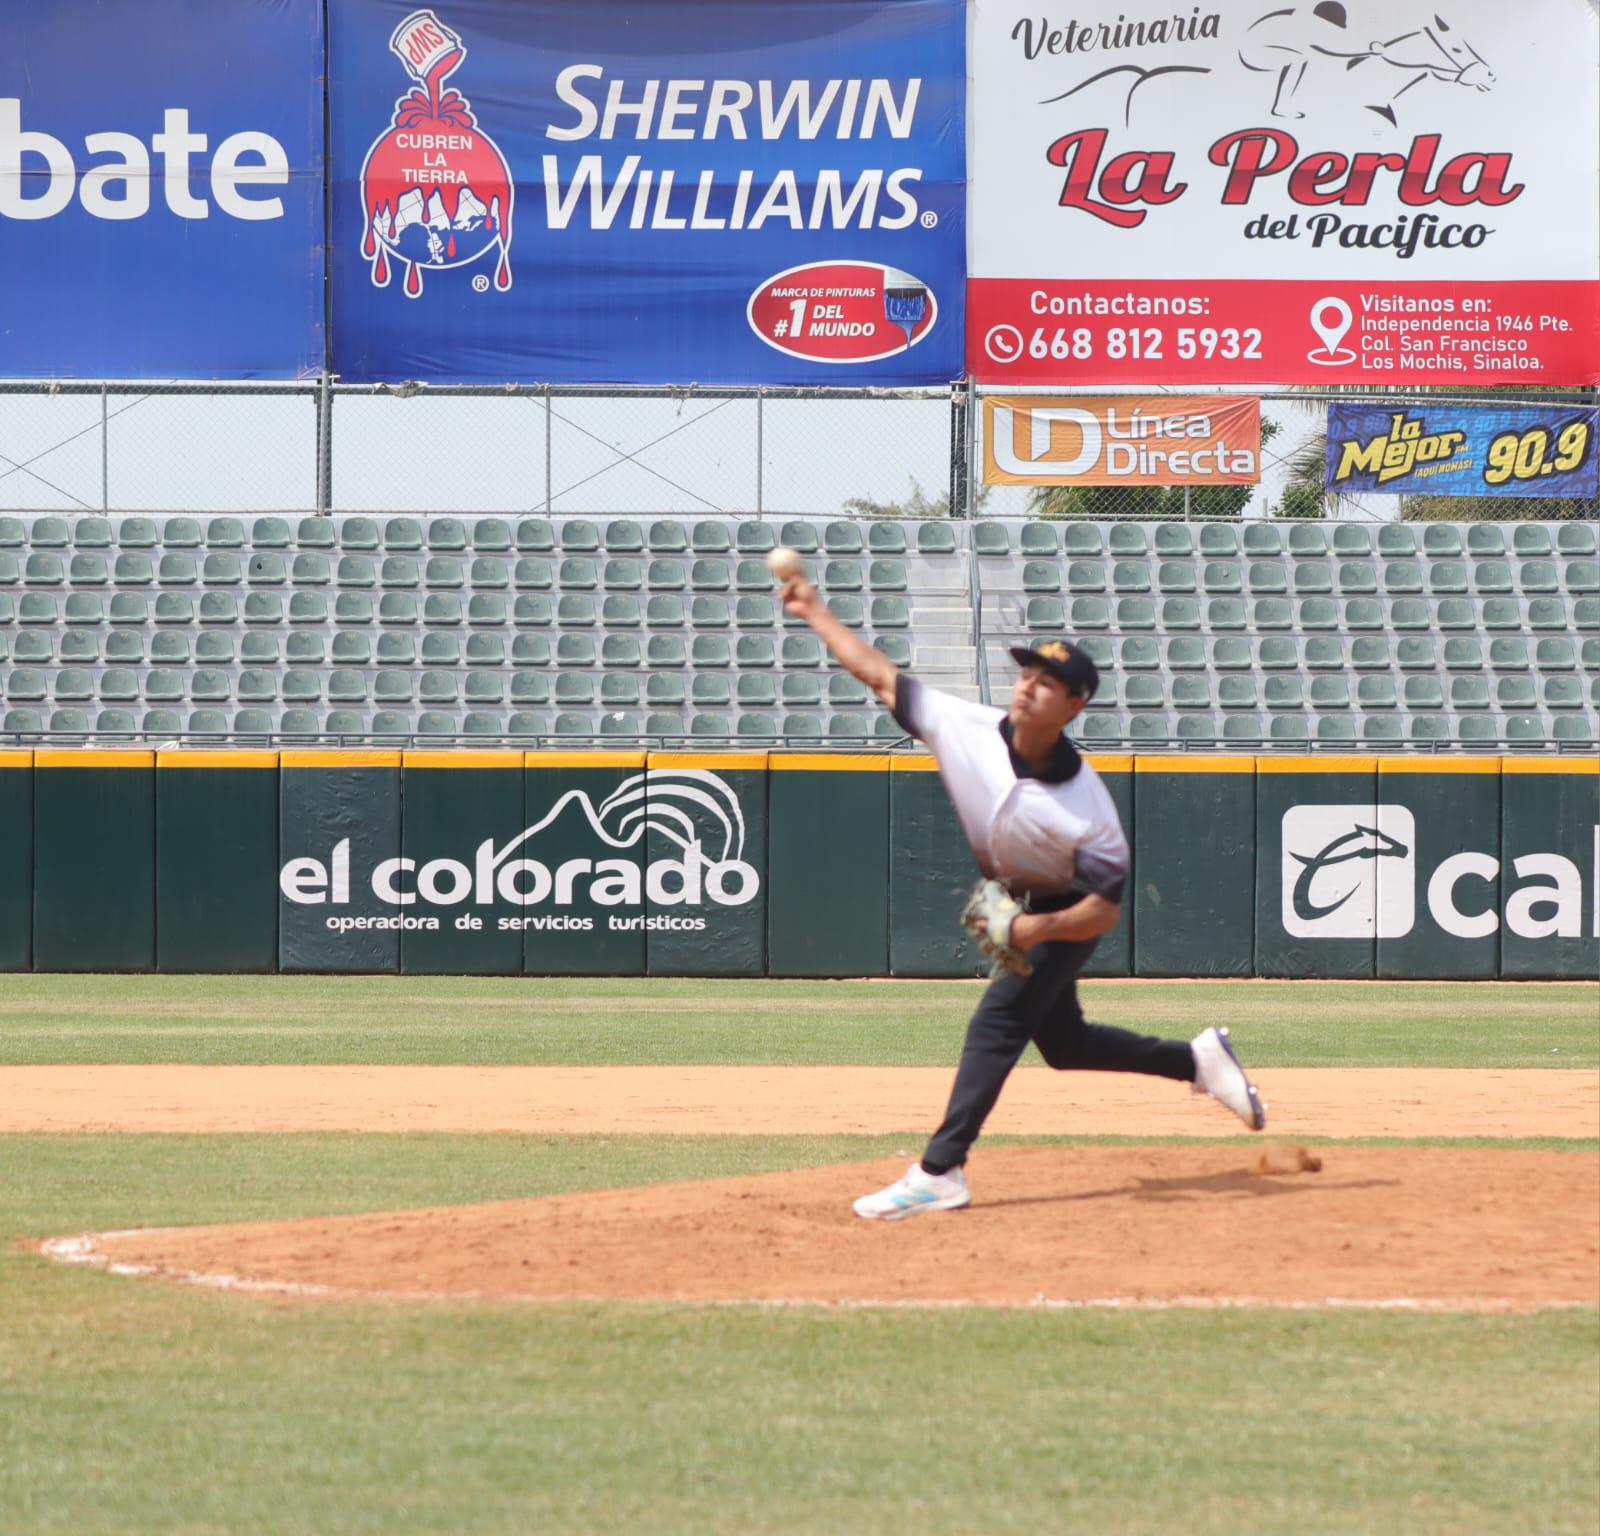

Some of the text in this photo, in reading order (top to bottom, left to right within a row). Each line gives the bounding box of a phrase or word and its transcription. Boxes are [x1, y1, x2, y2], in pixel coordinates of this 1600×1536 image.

[405, 22, 444, 65] SWP
[1012, 7, 1221, 60] Veterinaria
[545, 64, 922, 142] SHERWIN
[396, 133, 473, 150] CUBREN
[0, 97, 289, 220] bate
[423, 152, 447, 167] LA
[402, 168, 469, 184] TIERRA
[1046, 127, 1525, 229] La Perla
[1243, 212, 1496, 259] del Pacifico
[771, 288, 876, 297] MARCA DE PINTURAS
[1030, 290, 1211, 315] Contactanos:
[1360, 294, 1492, 313] Visitanos en:
[773, 299, 844, 337] #1 DEL
[809, 323, 875, 336] MUNDO
[1360, 315, 1573, 335] Independencia 1946 Pte.
[1029, 328, 1264, 360] 668 812 5932
[1361, 336, 1528, 352] Col. San Francisco
[1361, 353, 1545, 372] Los Mochis, Sinaloa.
[1106, 407, 1211, 440] Línea
[1390, 414, 1422, 441] la
[1106, 441, 1255, 475] Directa
[1336, 432, 1464, 483] Mejor
[1485, 422, 1588, 484] 90.9
[280, 838, 760, 906] el colorado
[326, 912, 706, 934] operadora de servicios turísticos
